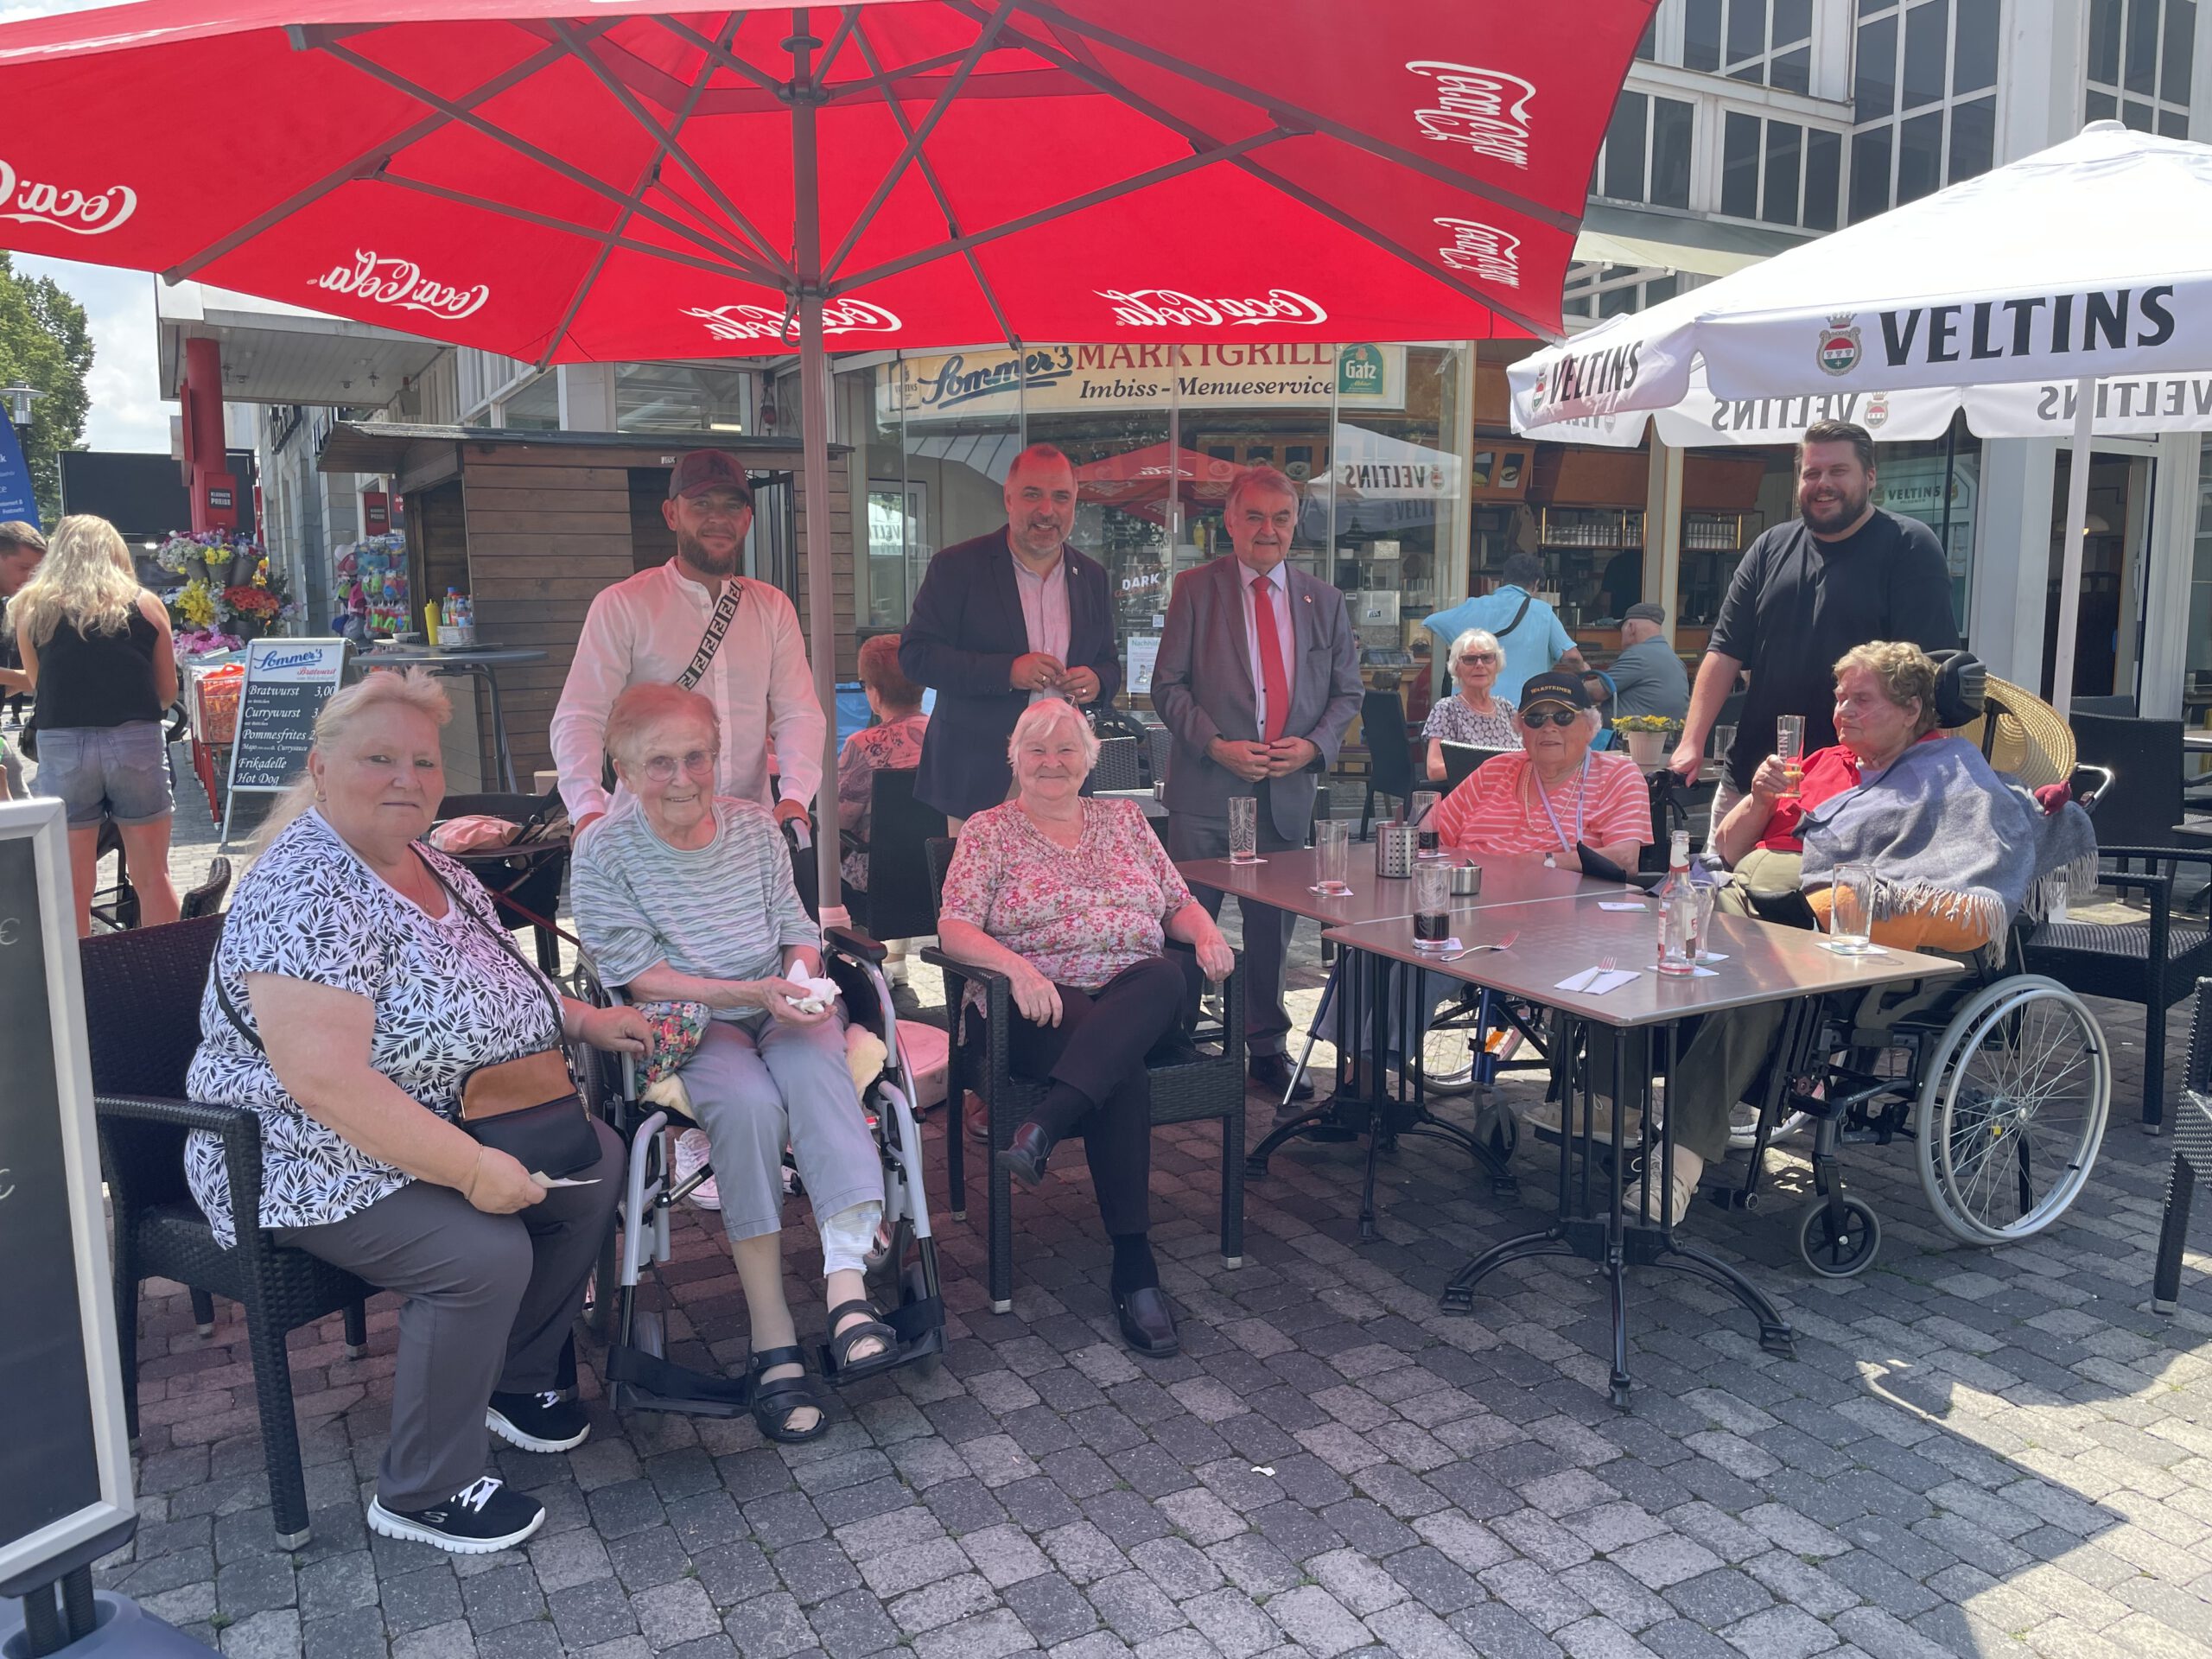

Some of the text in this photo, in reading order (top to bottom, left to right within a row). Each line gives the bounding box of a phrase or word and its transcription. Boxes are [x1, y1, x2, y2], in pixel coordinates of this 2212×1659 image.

[1878, 284, 2175, 366] VELTINS
[1345, 359, 1376, 379] Gatz
[1549, 340, 1644, 404] VELTINS
[1079, 379, 1158, 398] Imbiss
[1176, 374, 1333, 396] Menueservice
[1888, 486, 1942, 501] VELTINS
[1122, 572, 1160, 591] DARK
[253, 649, 323, 671] Sommer's
[248, 684, 336, 698] Bratwurst 3,00
[245, 706, 302, 721] Currywurst
[242, 728, 307, 744] Pommesfrites
[238, 756, 287, 771] Frikadelle
[236, 772, 280, 787] Hot Dog
